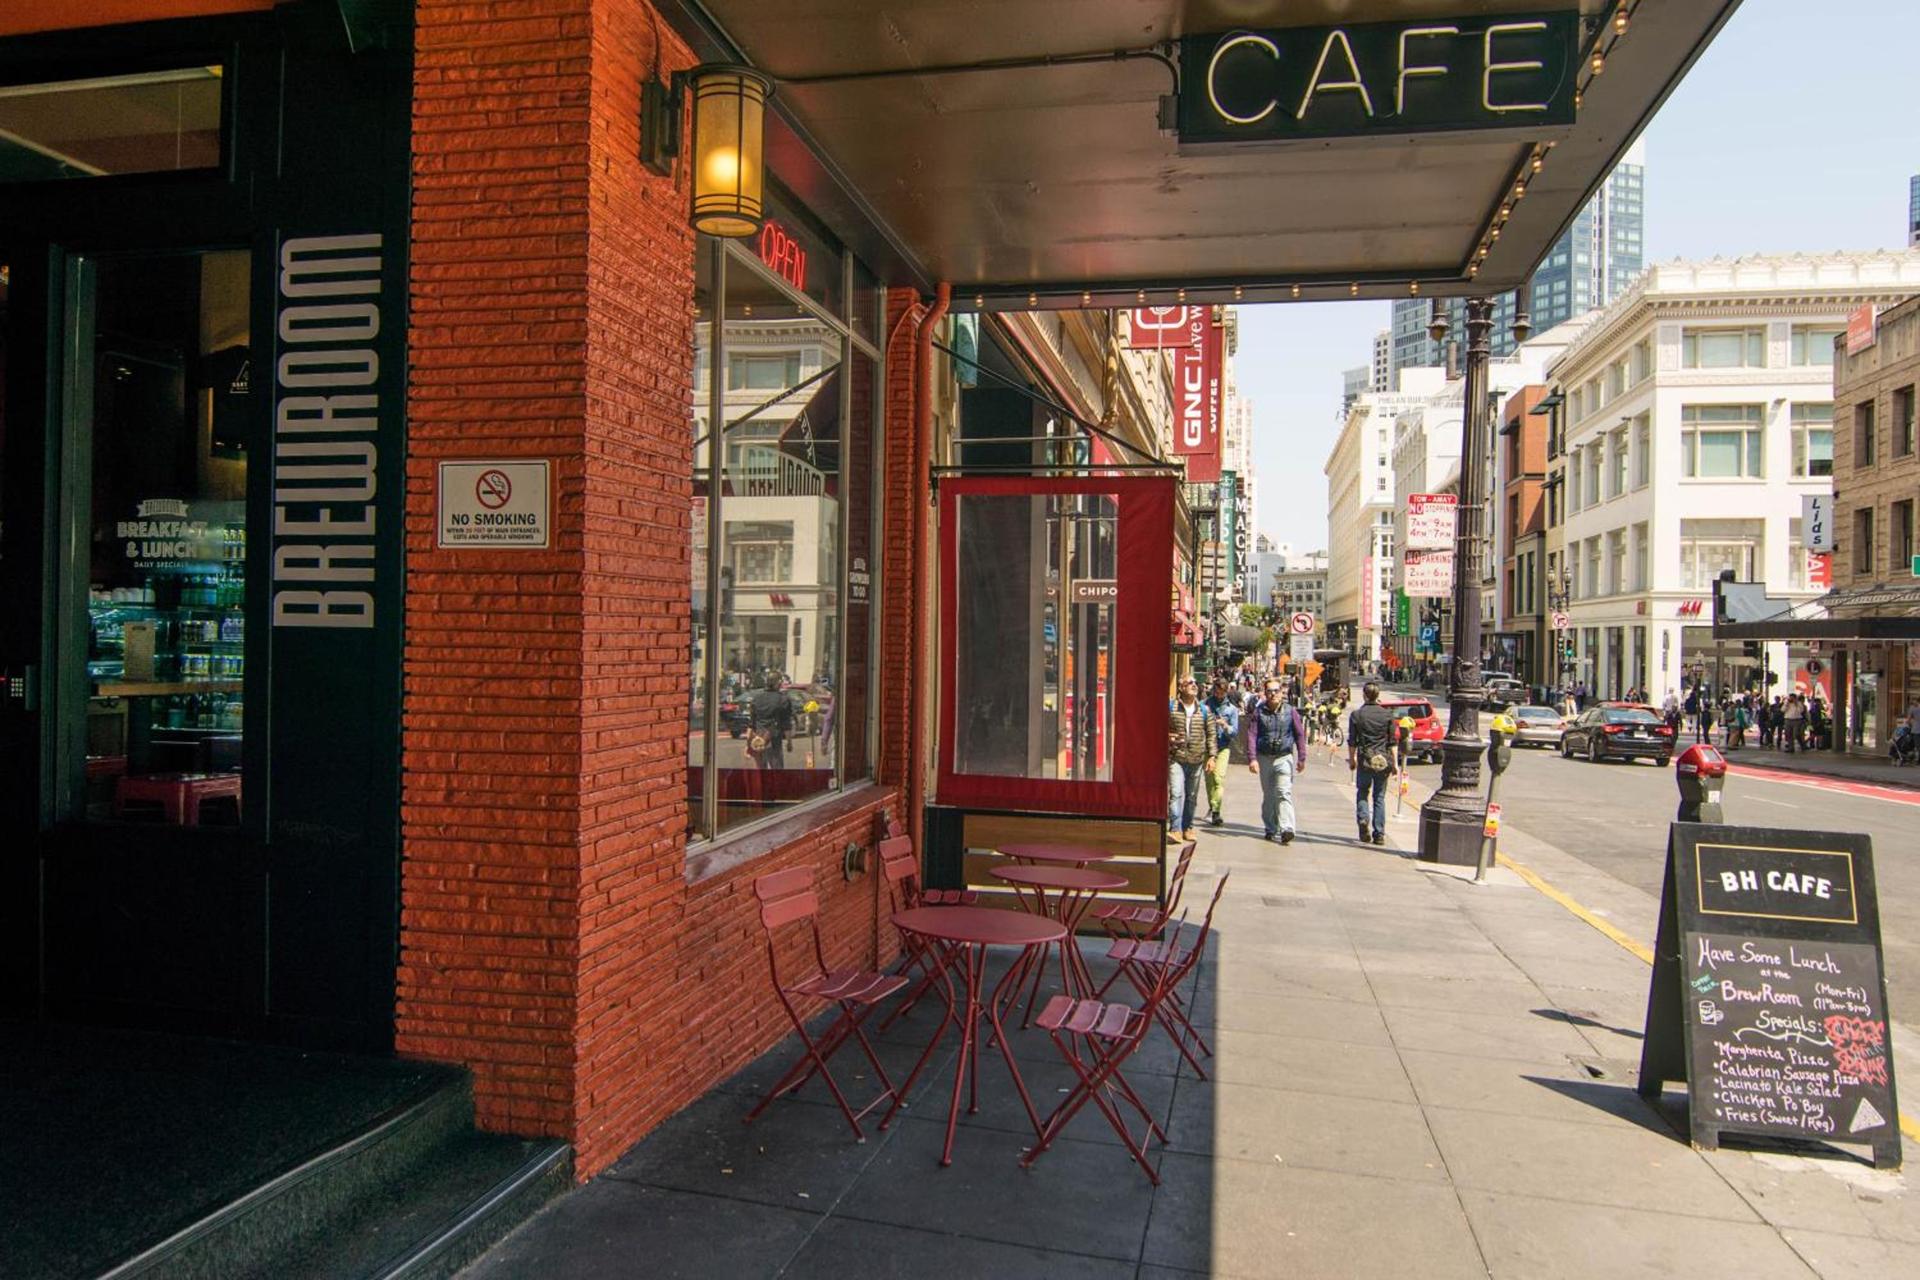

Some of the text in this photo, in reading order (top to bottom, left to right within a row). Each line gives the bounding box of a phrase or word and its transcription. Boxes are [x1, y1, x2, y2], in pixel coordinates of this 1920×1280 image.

[1208, 22, 1548, 124] CAFE
[762, 223, 806, 291] OPEN
[1184, 366, 1202, 447] GNC
[273, 233, 383, 628] BREWROOM
[451, 513, 536, 526] NO SMOKING
[1410, 504, 1423, 514] NO
[117, 521, 208, 538] BREAKFAST
[1812, 499, 1823, 544] Lids
[126, 541, 197, 558] & LUNCH
[1235, 498, 1246, 589] MACY'S
[1406, 552, 1451, 564] NO PARKING
[1079, 586, 1118, 596] CHIPO
[1720, 870, 1831, 900] BH CAFE
[1698, 937, 1841, 974] Have Some Lunch
[1760, 968, 1791, 979] at the
[1721, 979, 1803, 1008] BrewRoom
[1815, 982, 1867, 1003] (Mon-Fri)
[1756, 1010, 1823, 1034] Specials:
[1719, 1042, 1829, 1067] Margherita Pizza
[1720, 1061, 1860, 1085] Calabrian Sausage Pizza
[1720, 1076, 1841, 1098] Lacinato Kale Salad
[1721, 1090, 1776, 1108] Chicken
[1726, 1108, 1758, 1122] Fries
